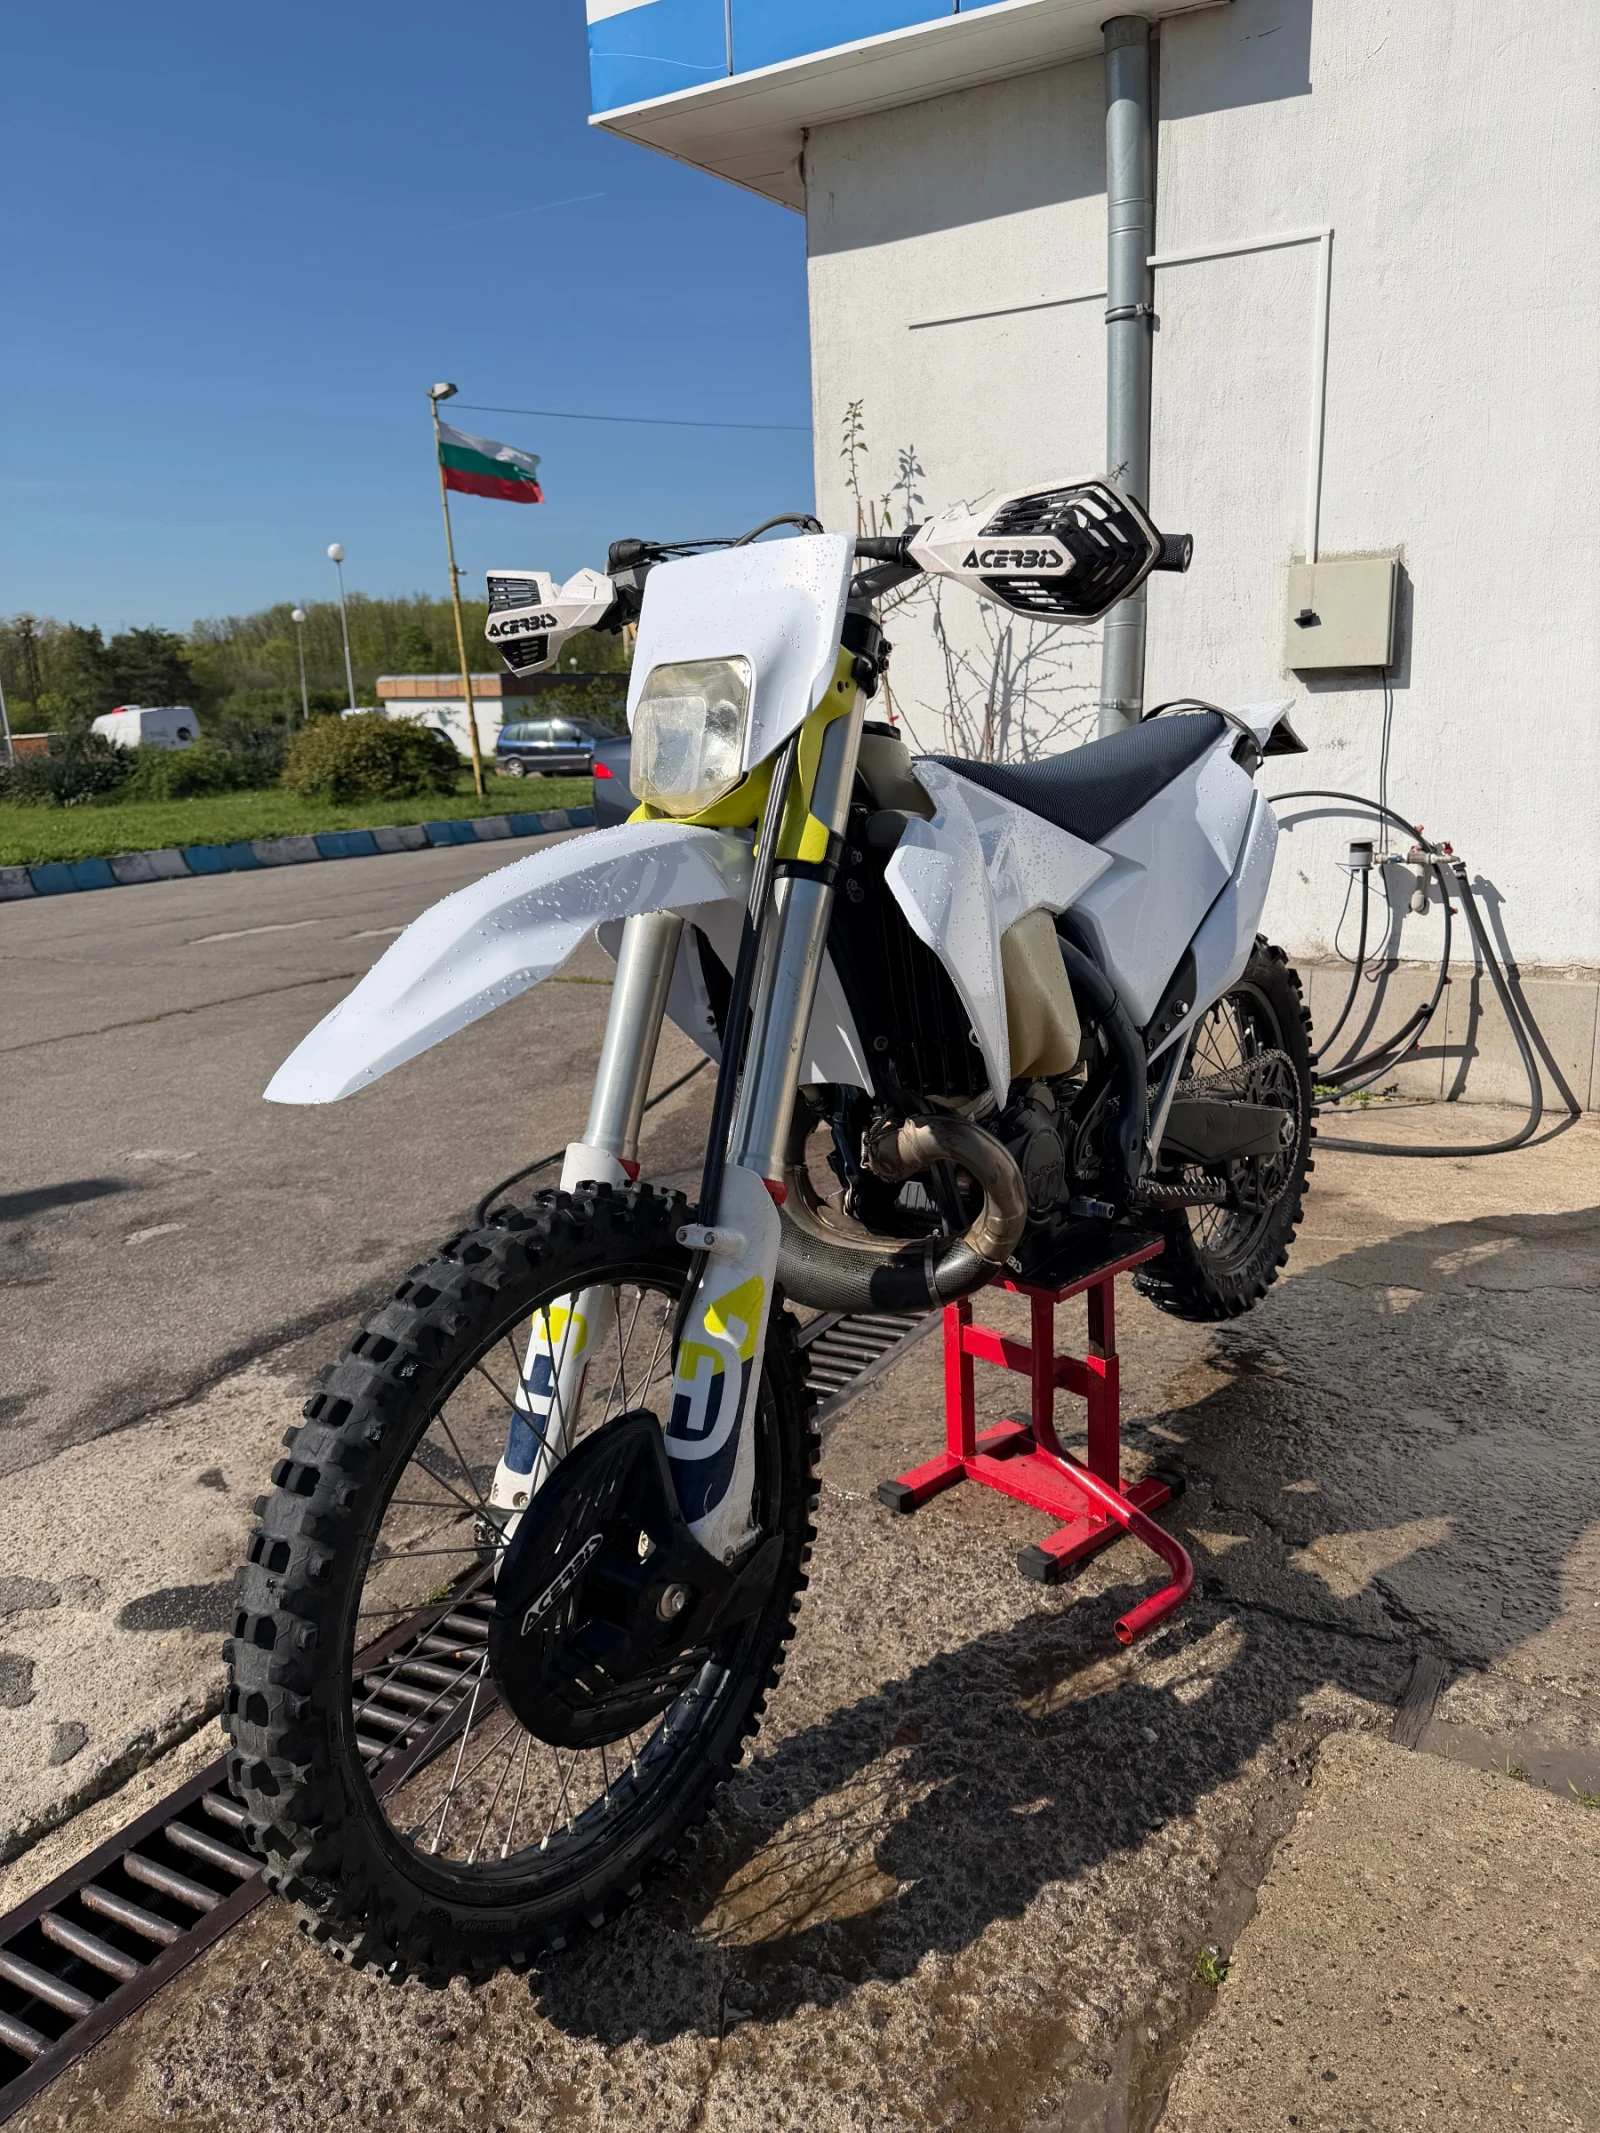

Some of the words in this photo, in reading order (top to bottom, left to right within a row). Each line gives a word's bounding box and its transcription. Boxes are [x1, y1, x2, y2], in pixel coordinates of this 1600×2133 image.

[962, 547, 1063, 568] ACERBIS
[488, 613, 558, 637] ACERBIS
[522, 1535, 603, 1635] ACERBIS
